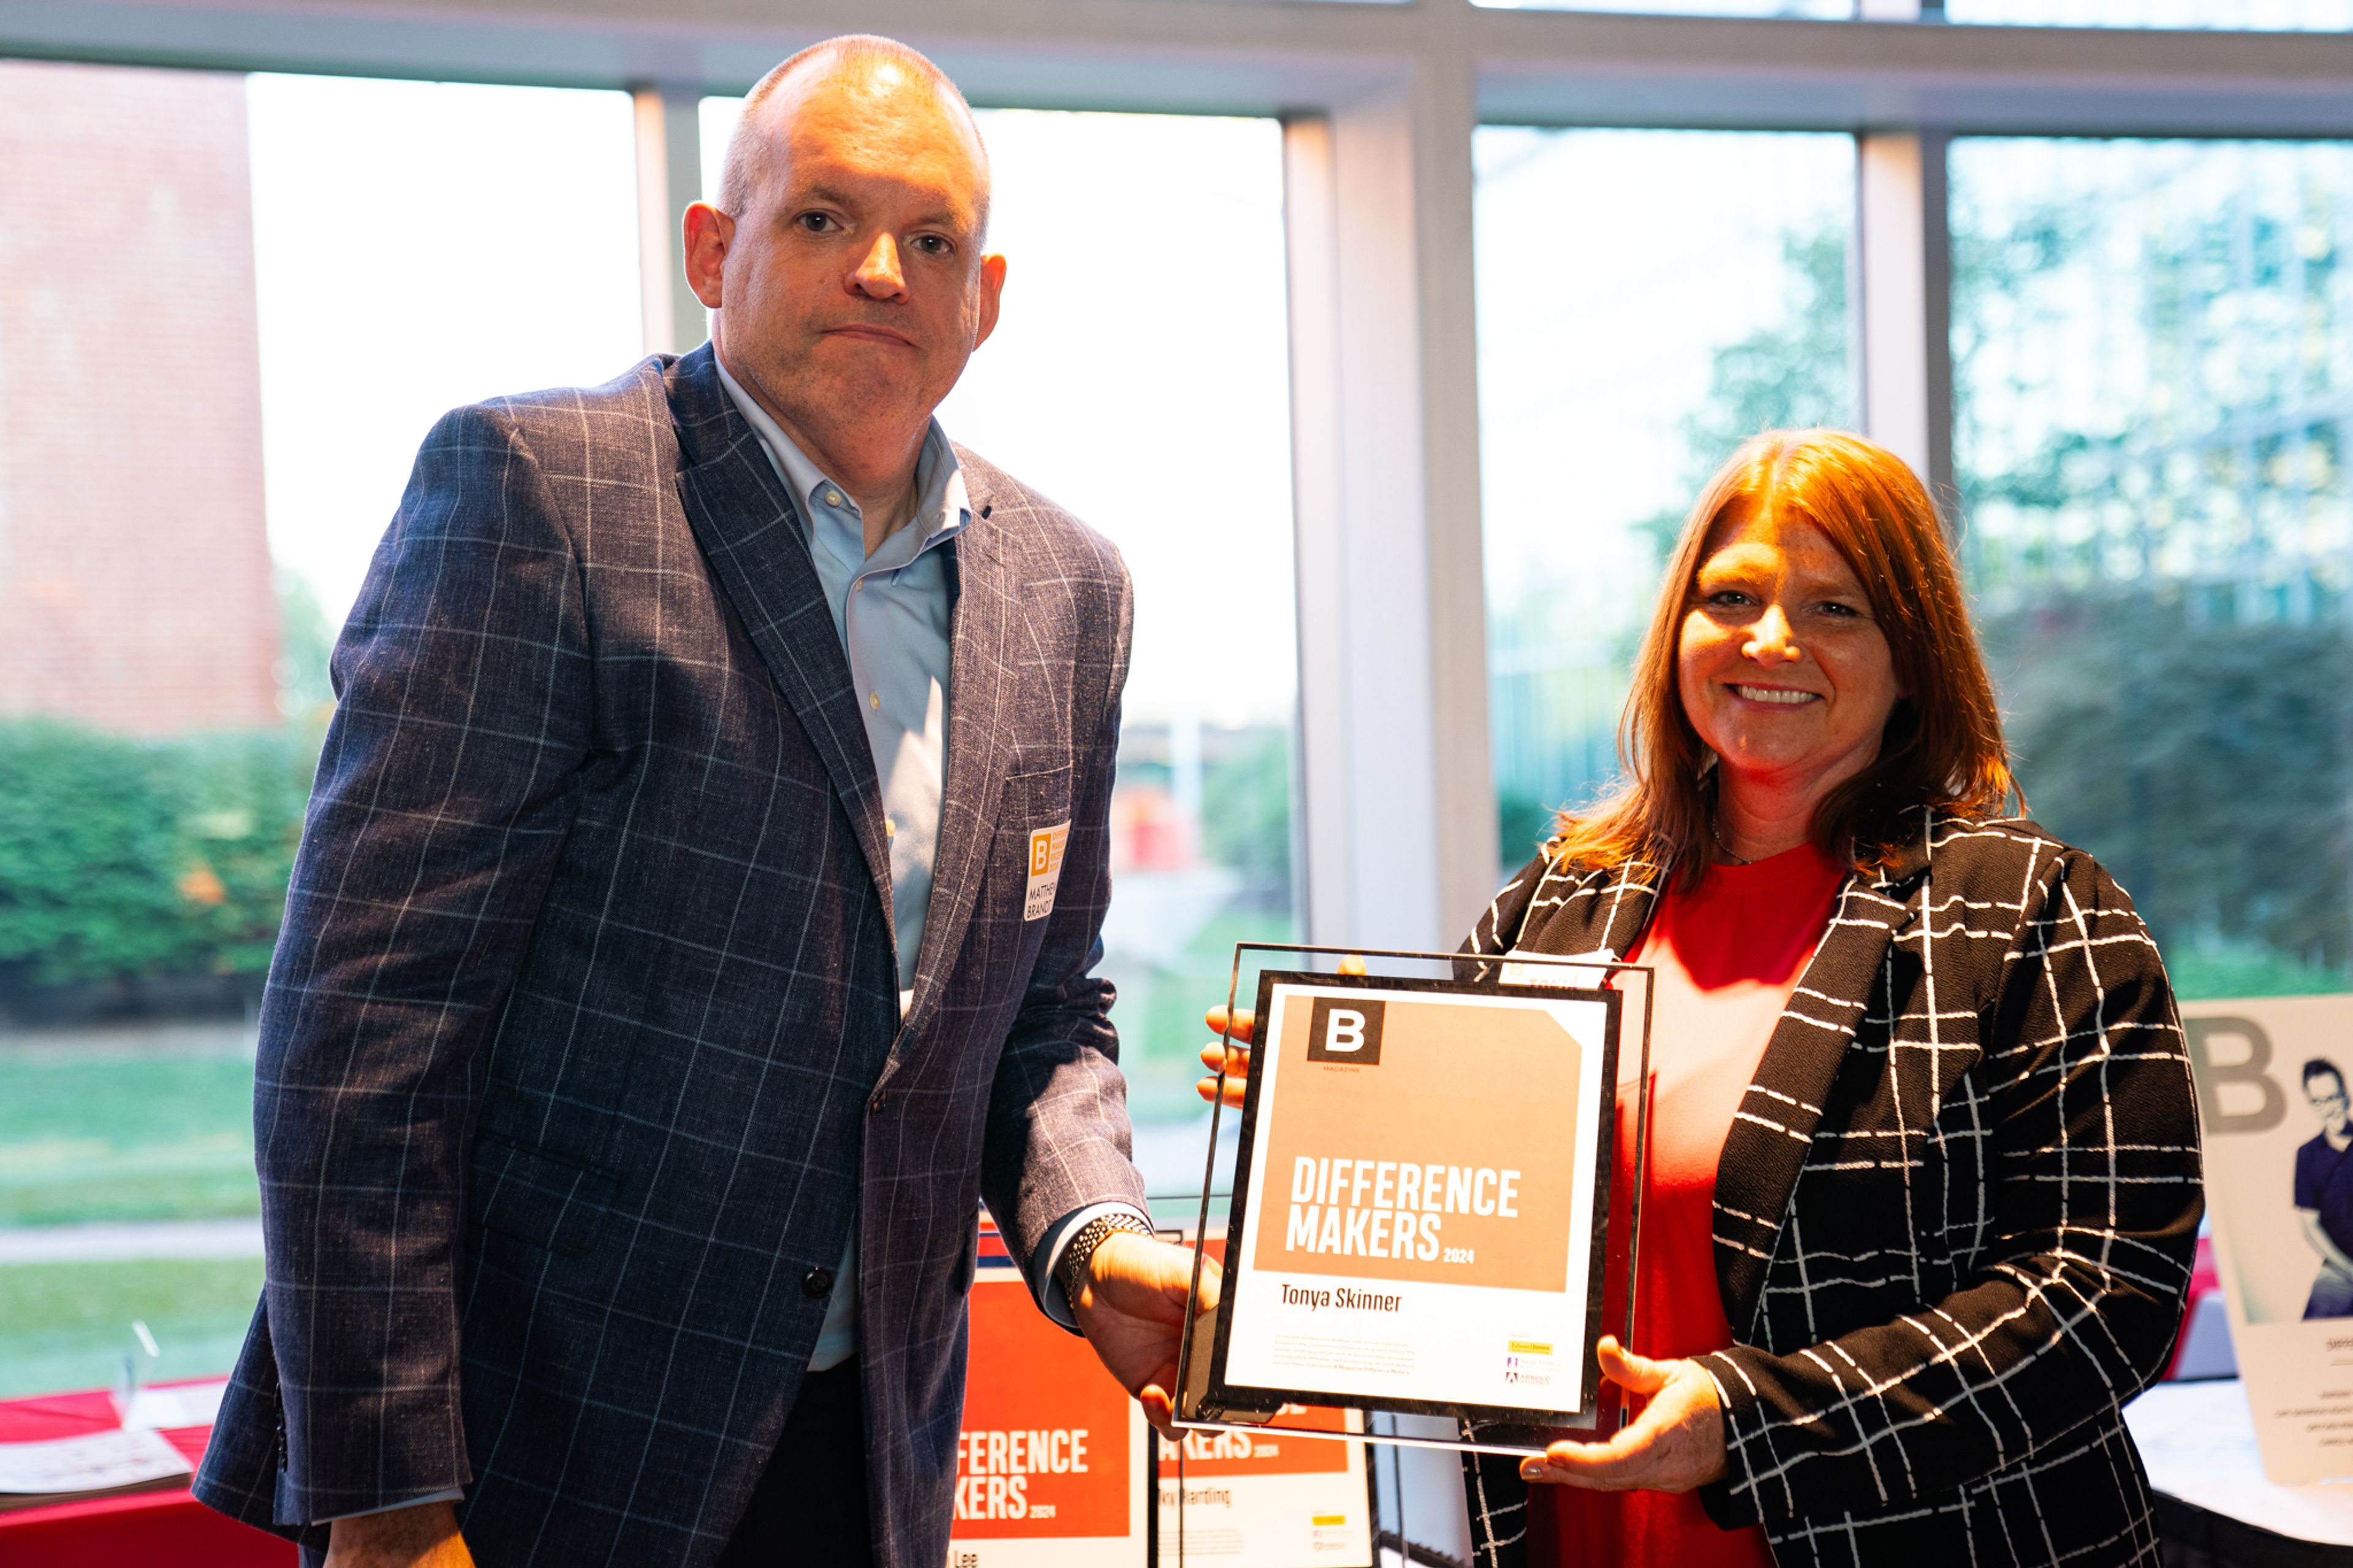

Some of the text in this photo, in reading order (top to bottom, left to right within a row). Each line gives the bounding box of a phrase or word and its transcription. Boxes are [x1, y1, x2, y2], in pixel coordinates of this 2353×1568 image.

[1036, 840, 1047, 871] B
[1325, 1009, 1366, 1052] B
[2183, 1017, 2289, 1135] B
[1291, 1156, 1521, 1218] DIFFERENCE
[1286, 1205, 1475, 1265] MAKERS 2024
[1282, 1284, 1403, 1312] Tonya Skinner
[957, 1430, 1089, 1474] FERENCE
[1159, 1430, 1252, 1461] AKERS
[953, 1475, 1056, 1520] KERS 2024
